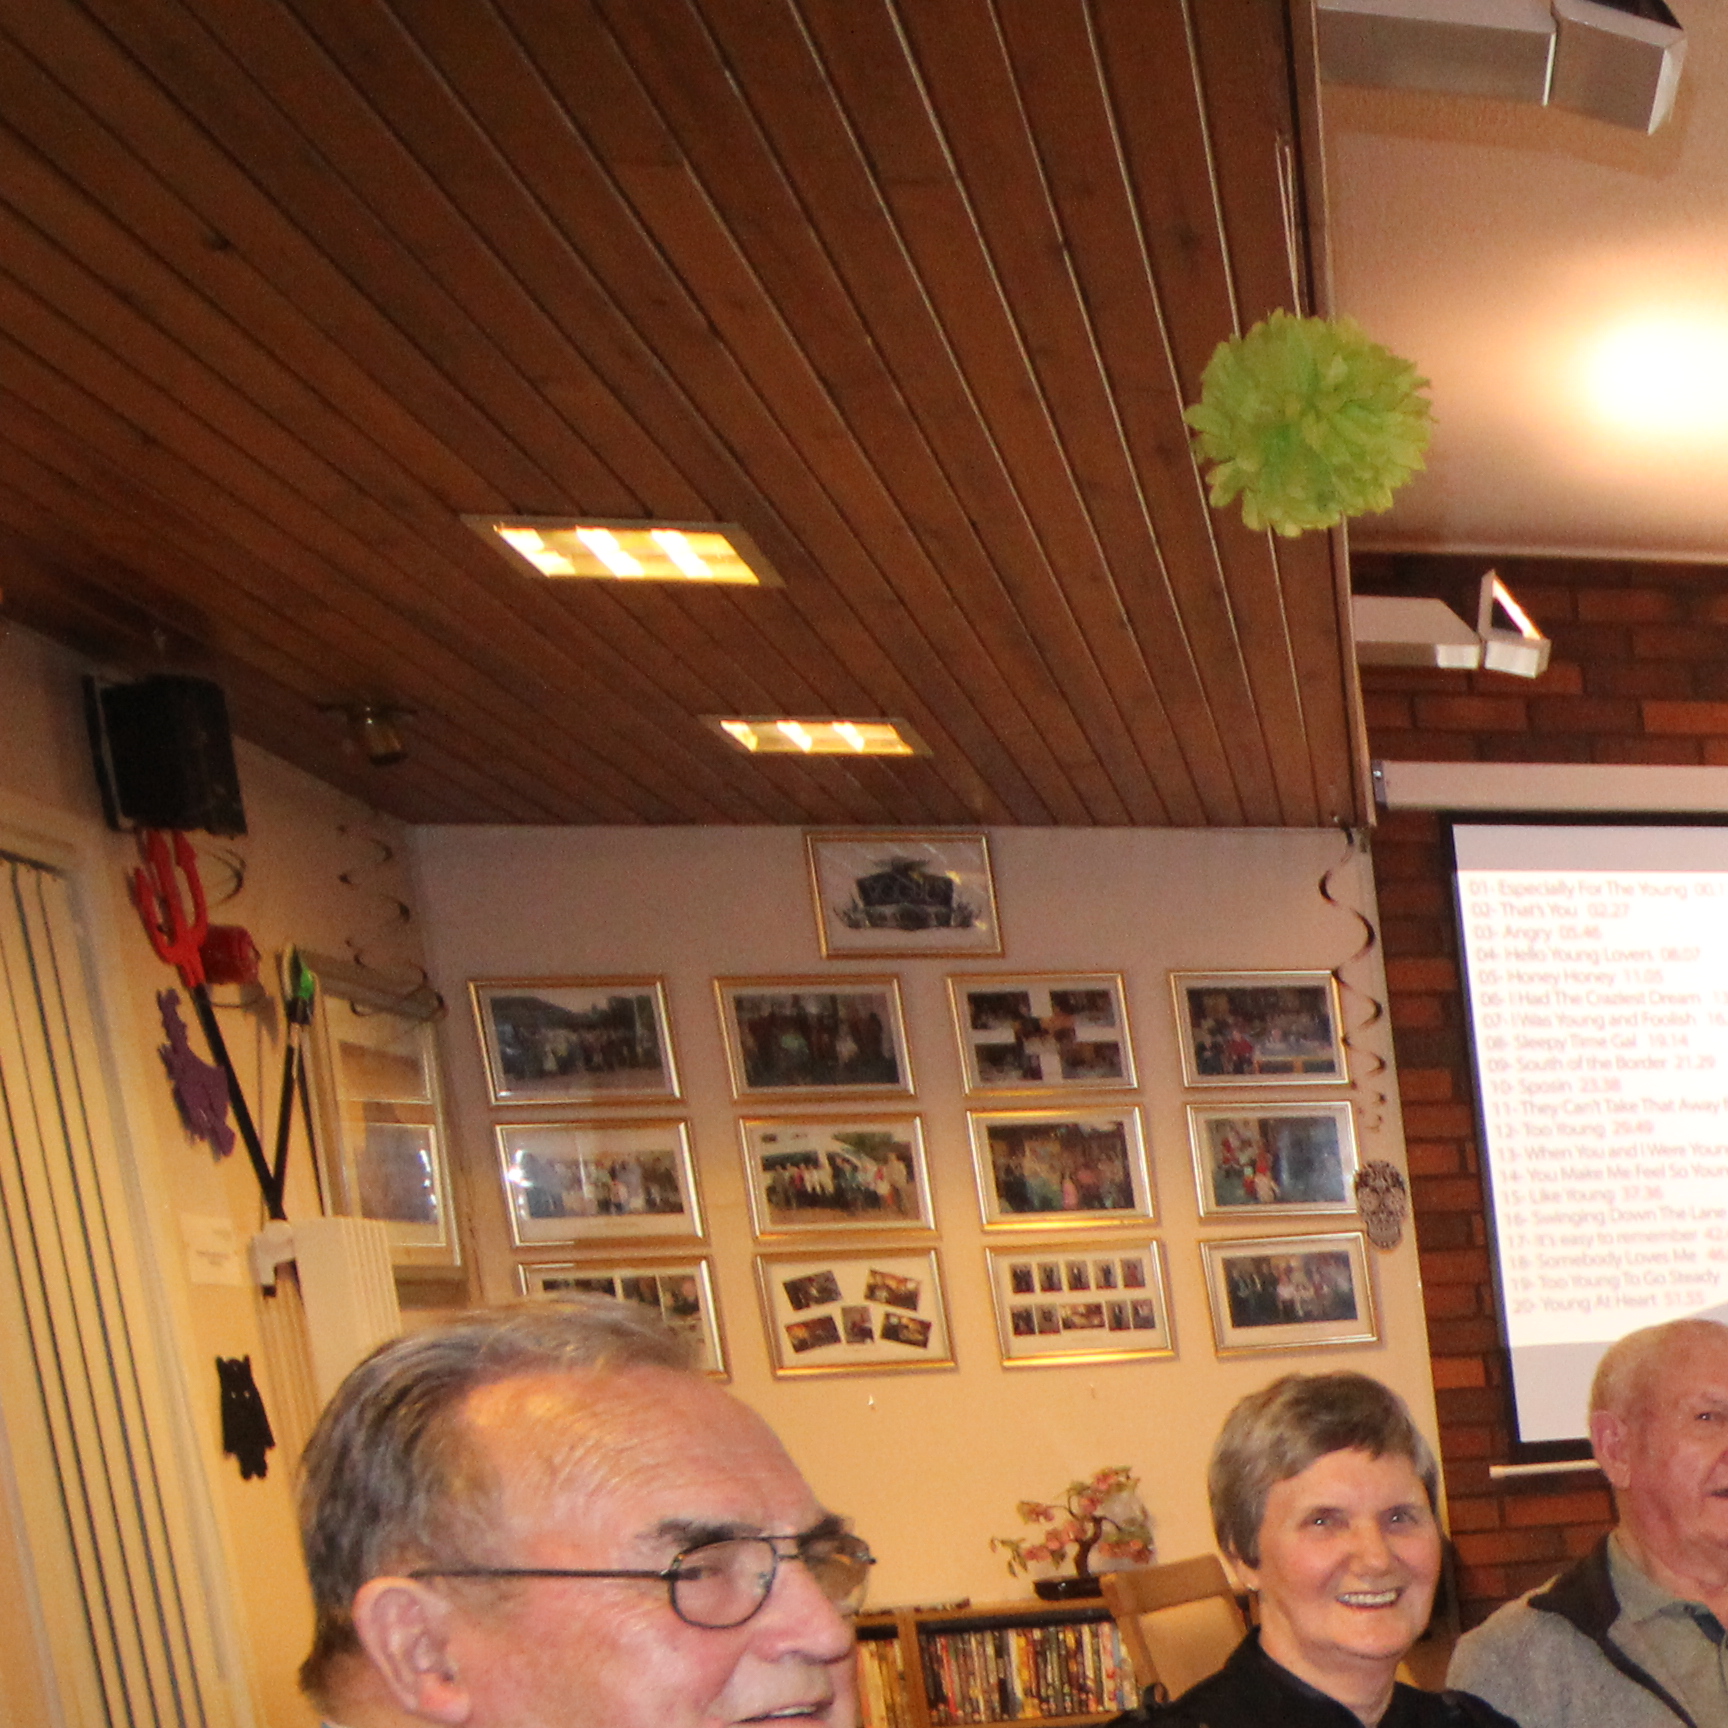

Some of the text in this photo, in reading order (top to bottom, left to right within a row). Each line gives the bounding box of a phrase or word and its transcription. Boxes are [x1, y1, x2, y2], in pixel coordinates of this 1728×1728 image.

[1498, 880, 1573, 900] Especially
[1578, 880, 1601, 896] For
[1606, 880, 1634, 896] The
[1638, 882, 1687, 900] Young
[1547, 903, 1577, 918] You
[1503, 925, 1551, 942] Angry
[1504, 946, 1546, 962] Hello
[1547, 947, 1599, 966] Young
[1602, 947, 1653, 962] Lovers
[1507, 970, 1559, 988] Honey
[1563, 970, 1615, 988] Honey
[1518, 991, 1549, 1005] Had
[1554, 991, 1583, 1005] The
[1585, 990, 1645, 1006] Craziest
[1649, 989, 1701, 1005] Dream
[1518, 1012, 1551, 1028] Was
[1554, 1012, 1605, 1031] Young
[1608, 1011, 1638, 1027] and
[1641, 1011, 1696, 1027] Foolish
[1513, 1033, 1566, 1052] Sleepy
[1569, 1033, 1607, 1049] Time
[1610, 1032, 1637, 1048] Gal
[1516, 1055, 1563, 1071] South
[1566, 1053, 1583, 1070] of
[1585, 1055, 1613, 1070] the
[1616, 1054, 1667, 1070] Border
[1519, 1099, 1558, 1119] They
[1603, 1098, 1638, 1113] Take
[1640, 1097, 1674, 1112] That
[1679, 1096, 1720, 1115] Away
[1522, 1121, 1553, 1137] Too
[1556, 1120, 1606, 1138] Young
[1524, 1145, 1571, 1161] When
[1574, 1143, 1605, 1159] You
[1608, 1142, 1638, 1158] and
[1648, 1142, 1685, 1157] Were
[1526, 1167, 1558, 1182] You
[1560, 1165, 1603, 1181] Make
[1606, 1164, 1631, 1180] Me
[1635, 1163, 1665, 1179] Feel
[1668, 1162, 1689, 1178] So
[1528, 1188, 1560, 1204] Like
[1564, 1188, 1616, 1208] Young
[1531, 1210, 1605, 1229] Swinging
[1608, 1208, 1657, 1223] Down
[1658, 1204, 1686, 1220] The
[1688, 1204, 1727, 1220] Lane
[1560, 1232, 1594, 1249] easy
[1596, 1231, 1614, 1245] to
[1616, 1228, 1696, 1244] remember
[1535, 1250, 1622, 1270] Somebody
[1623, 1250, 1669, 1266] Loves
[1672, 1247, 1697, 1263] Me
[1538, 1274, 1568, 1290] Too
[1569, 1273, 1620, 1291] Young
[1622, 1271, 1640, 1286] To
[1643, 1270, 1667, 1286] Go
[1669, 1267, 1720, 1287] Steady
[1539, 1297, 1592, 1313] Young
[1593, 1294, 1611, 1310] At
[1615, 1292, 1656, 1309] Heart
